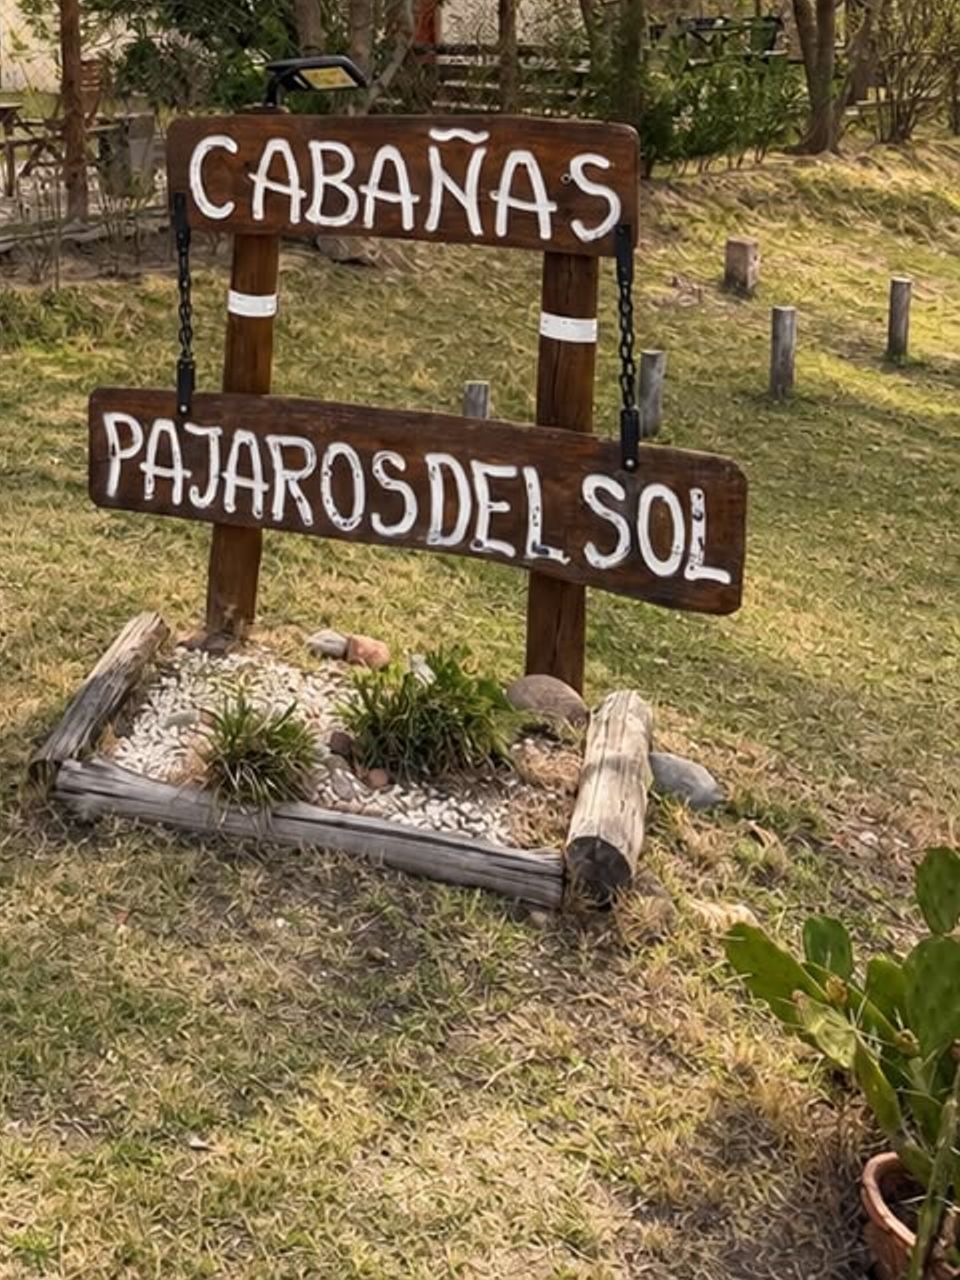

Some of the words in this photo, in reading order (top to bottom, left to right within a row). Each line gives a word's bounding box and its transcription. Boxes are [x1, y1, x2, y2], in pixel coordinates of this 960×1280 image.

[188, 128, 622, 242] CABAÑAS
[102, 412, 418, 537] PAJAROS
[424, 453, 571, 565] DEL
[581, 473, 732, 584] SOL
